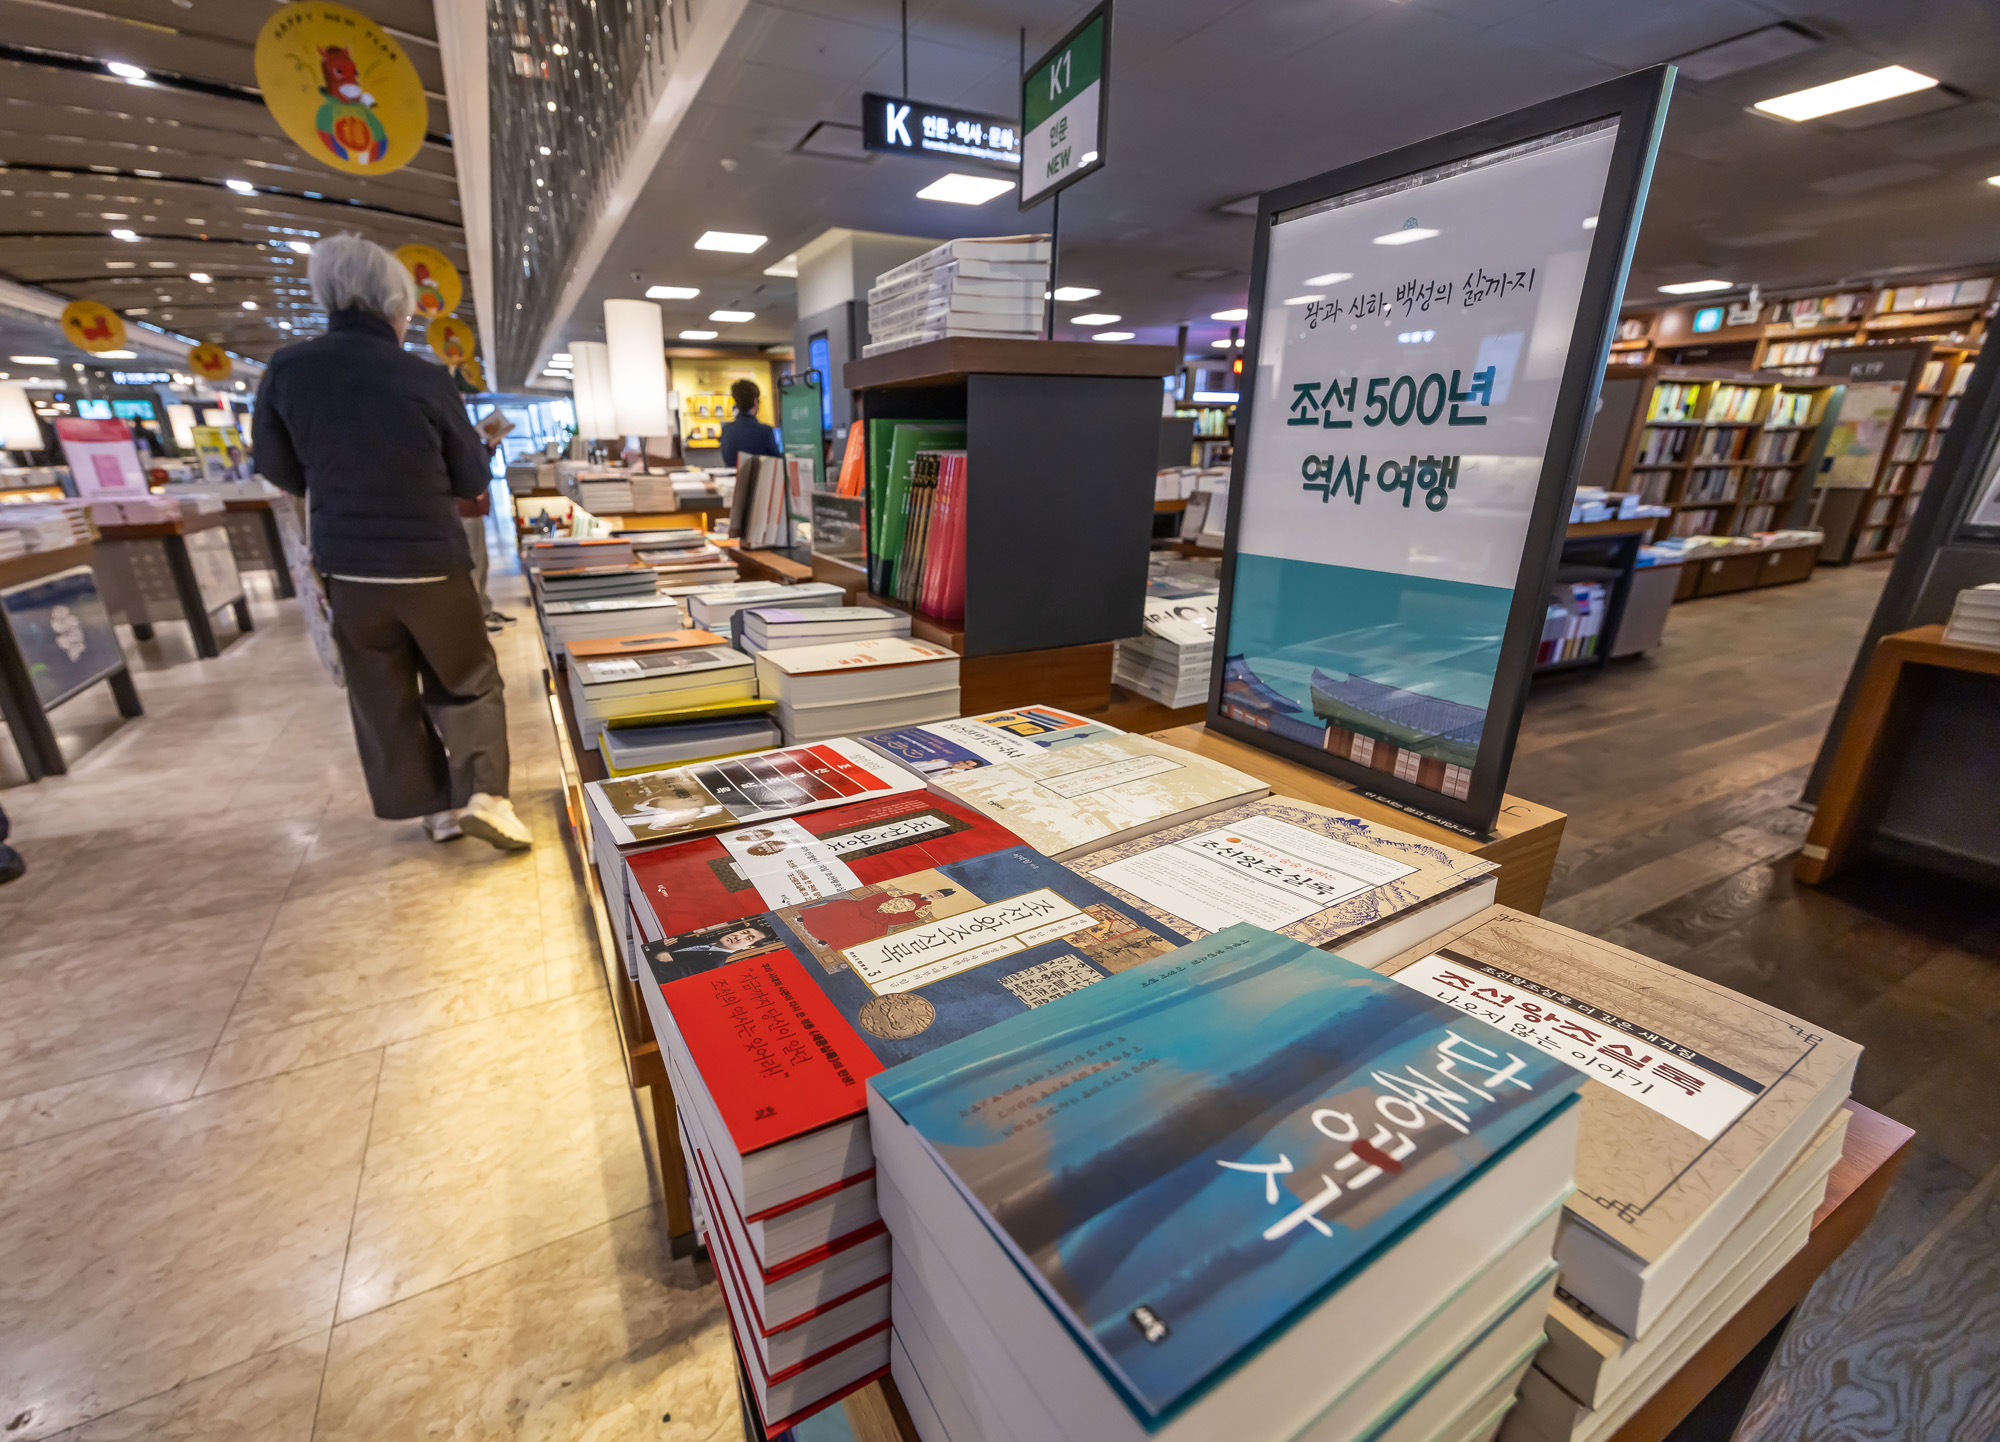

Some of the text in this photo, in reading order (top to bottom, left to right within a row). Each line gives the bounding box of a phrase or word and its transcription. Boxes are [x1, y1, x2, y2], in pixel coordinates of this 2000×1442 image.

[1049, 49, 1072, 101] K1
[886, 102, 913, 147] K
[1049, 115, 1069, 148] 인문
[1046, 147, 1071, 178] NEW
[1304, 267, 1537, 330] 왕과 신하, 백성의 삶까지
[1287, 365, 1497, 430] 조선 500년
[1301, 453, 1460, 513] 역사 여행
[1193, 839, 1337, 897] 조선왕조실록
[1241, 840, 1278, 860] 이야기로
[881, 898, 1056, 964] 조선왕조실록
[706, 977, 741, 1008] 조선의
[723, 1004, 761, 1039] 역사는
[1479, 965, 1574, 1008] 조선왕조실록
[1576, 1004, 1595, 1015] 더
[1600, 1013, 1633, 1032] 깊은
[758, 1006, 797, 1041] 당신이
[779, 1038, 814, 1067] 알던
[1432, 970, 1708, 1096] 조선왕조실록
[1435, 990, 1656, 1096] 나오지 않는 이야기
[1217, 1028, 1534, 1242] 단종애사
